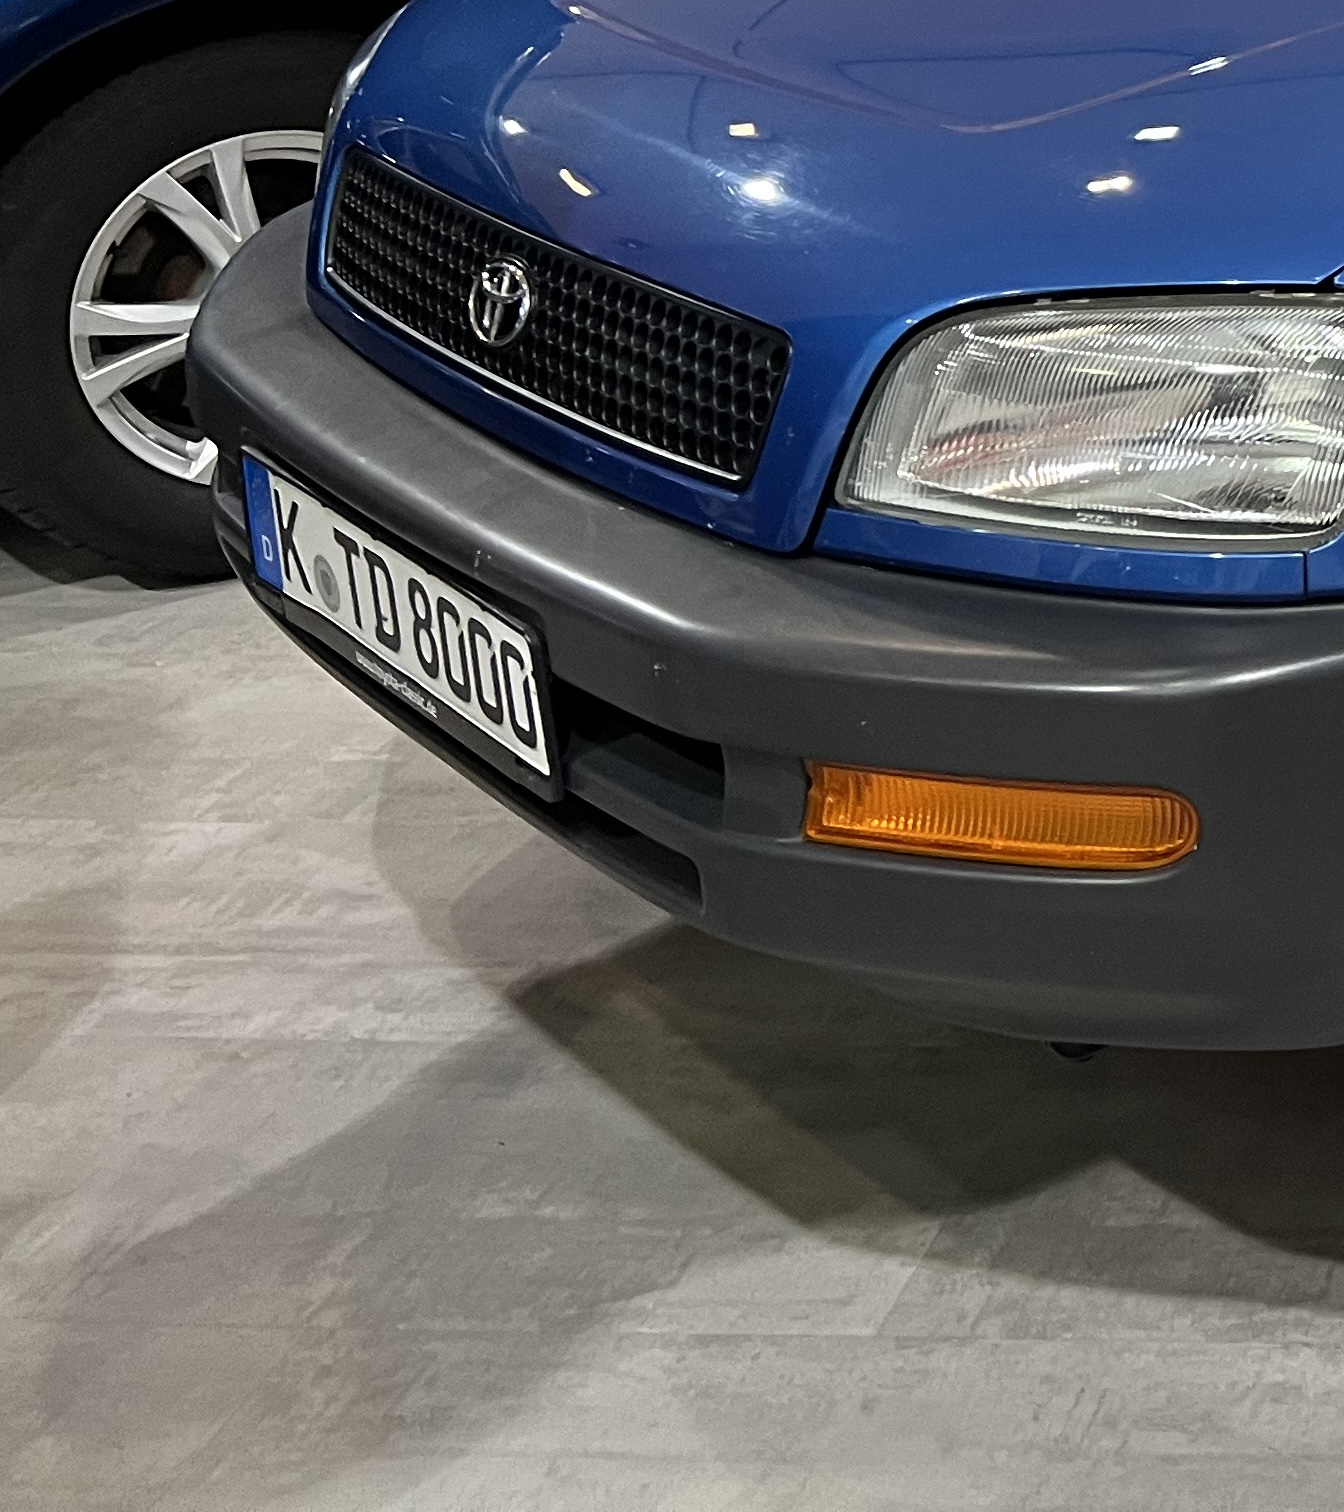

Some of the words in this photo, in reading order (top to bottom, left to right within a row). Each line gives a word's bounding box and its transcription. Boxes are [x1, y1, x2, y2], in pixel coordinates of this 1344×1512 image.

[261, 535, 274, 561] D
[273, 486, 313, 596] K
[333, 526, 401, 653] TD
[407, 577, 538, 749] 8000
